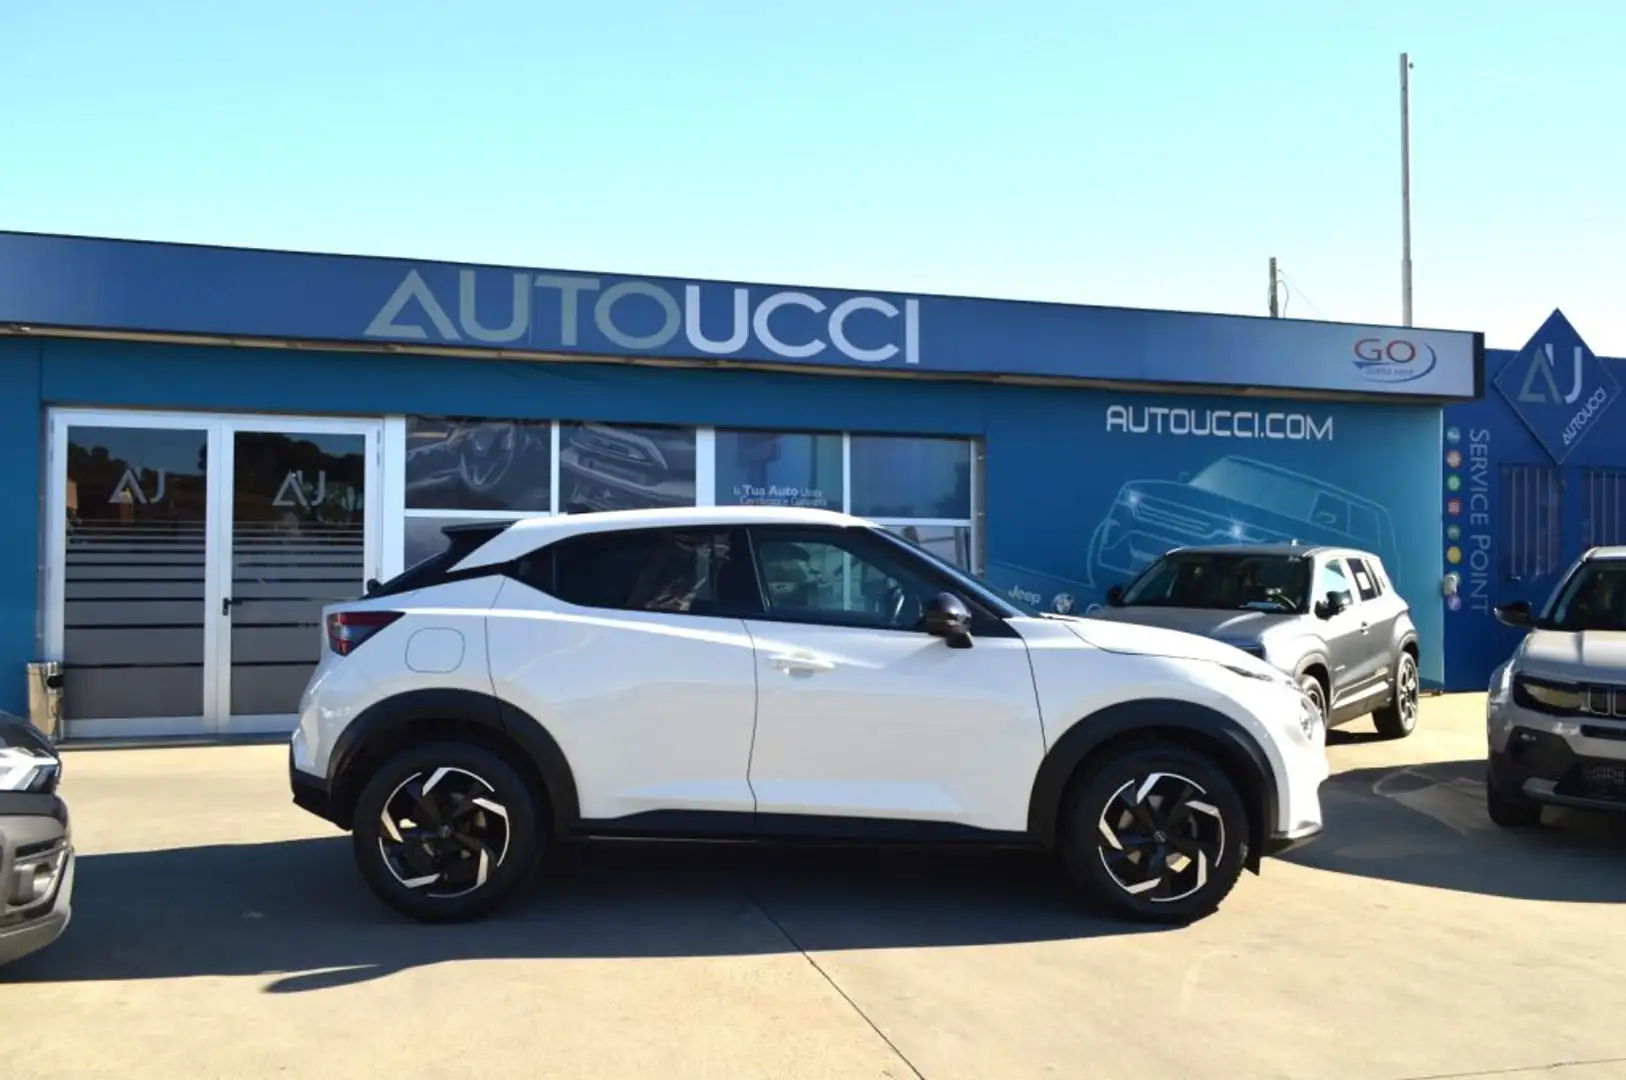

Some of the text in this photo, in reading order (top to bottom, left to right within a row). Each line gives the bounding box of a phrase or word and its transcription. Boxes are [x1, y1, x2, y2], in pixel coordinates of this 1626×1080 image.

[364, 269, 919, 364] AUTOUCCI
[1354, 338, 1416, 363] GO
[1106, 405, 1334, 441] AUTOUCCI.COM
[1562, 386, 1607, 445] AUTOUCCI
[742, 484, 766, 496] Tua
[768, 485, 799, 497] Auto
[1469, 429, 1491, 615] SERVICE POINT
[1008, 585, 1041, 606] Jeep
